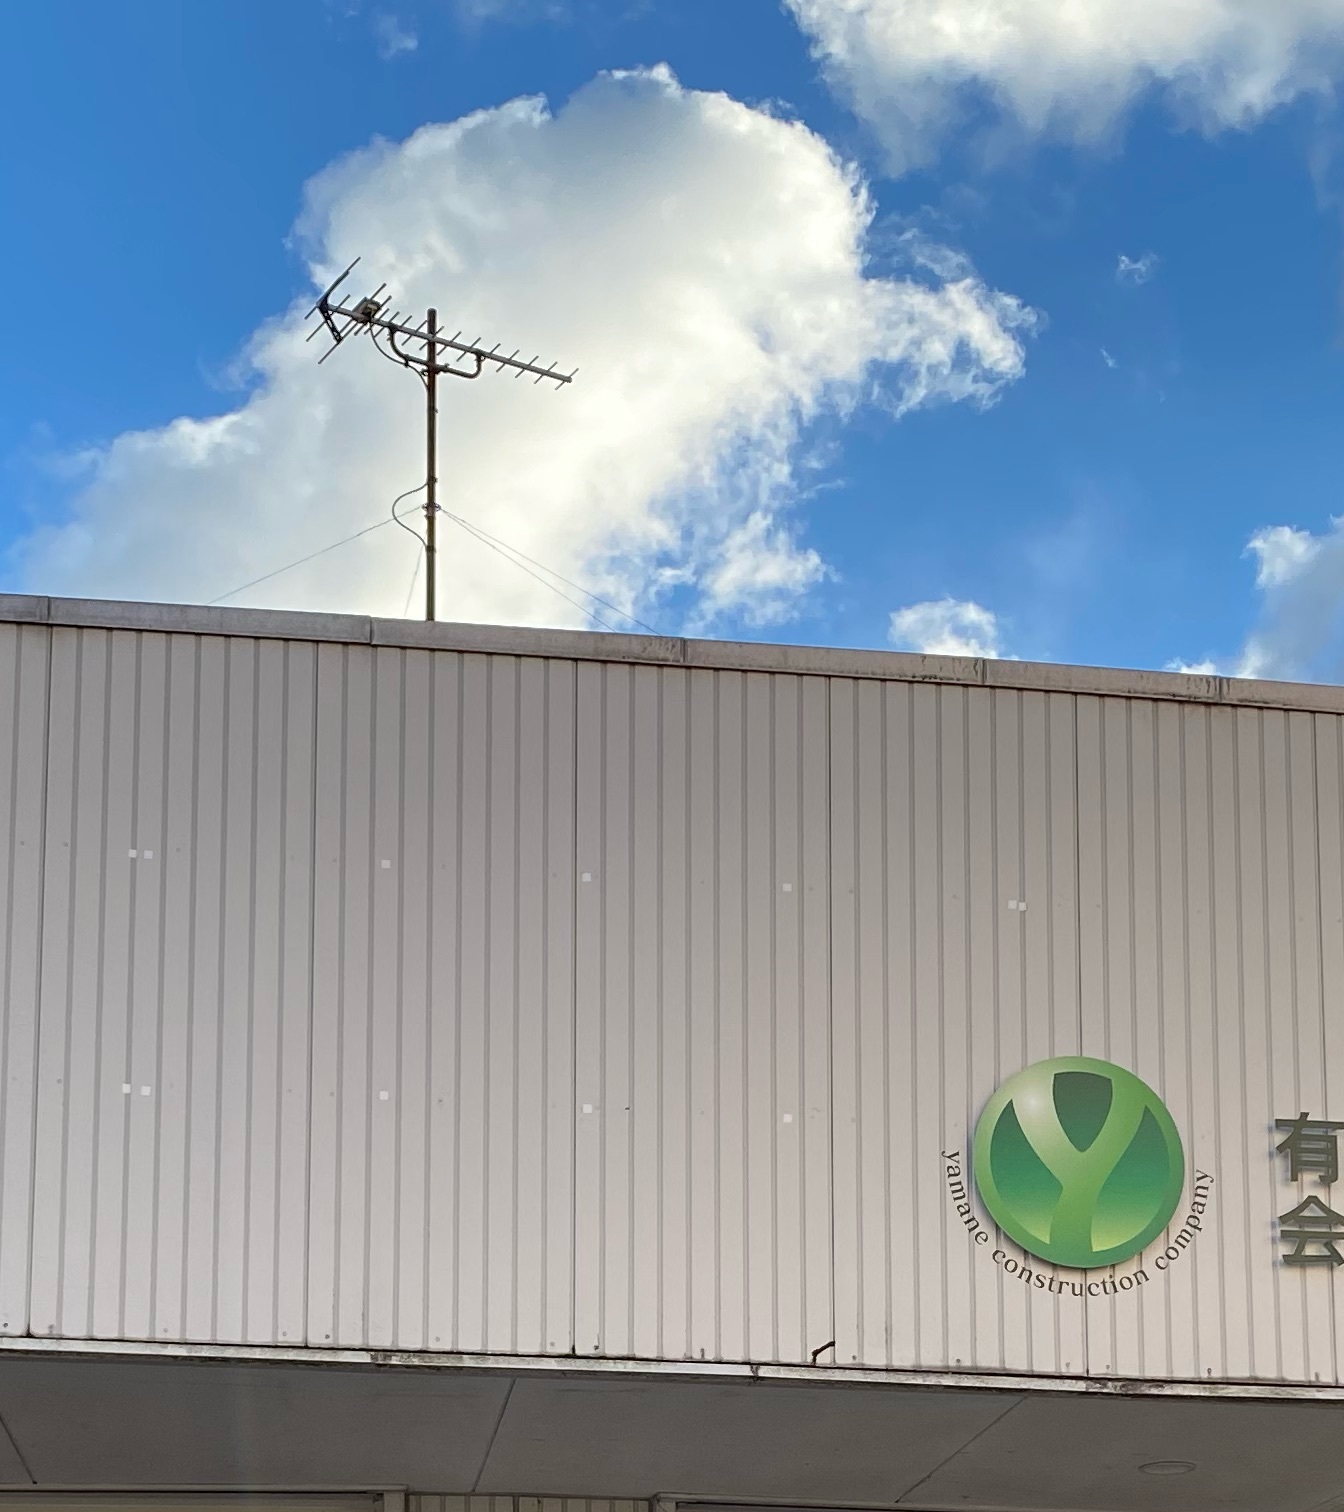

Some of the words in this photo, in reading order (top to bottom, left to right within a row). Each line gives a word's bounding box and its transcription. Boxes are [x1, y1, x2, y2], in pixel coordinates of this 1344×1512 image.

[941, 1150, 989, 1246] yamane
[991, 1249, 1151, 1298] construction
[1154, 1168, 1215, 1271] company
